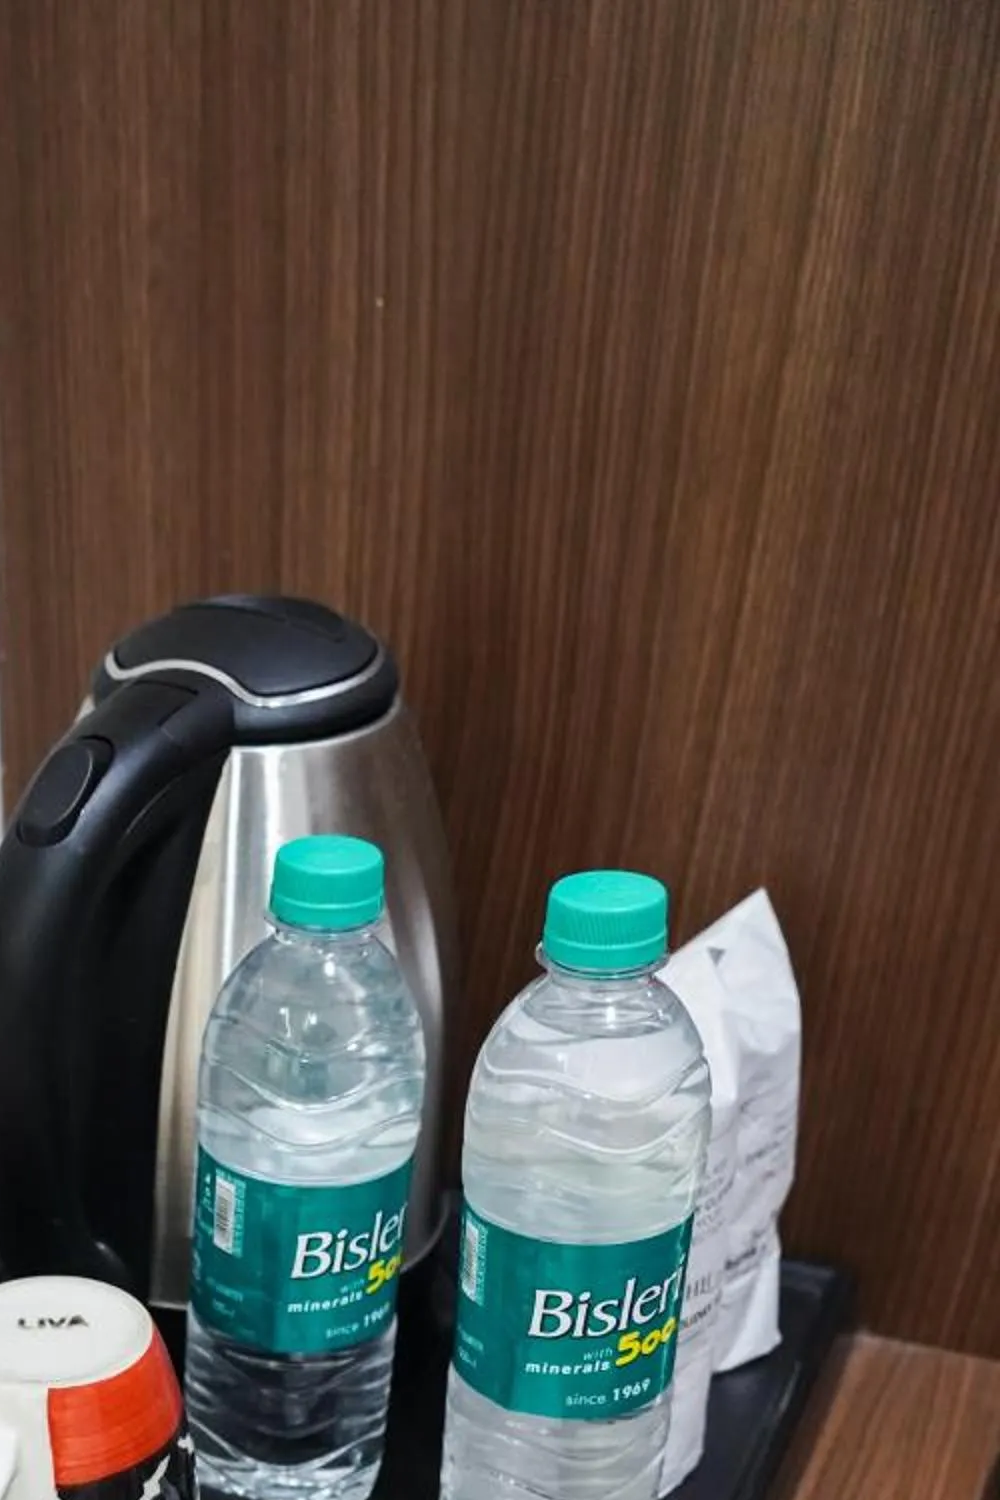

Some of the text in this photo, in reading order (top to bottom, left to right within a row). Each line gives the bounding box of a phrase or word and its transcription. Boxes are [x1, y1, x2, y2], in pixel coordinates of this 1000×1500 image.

[290, 1202, 407, 1279] Bisler
[288, 1291, 362, 1313] minerals
[527, 1253, 686, 1338] Bisleri
[17, 1314, 89, 1329] LIVA
[615, 1317, 676, 1367] 500
[525, 1360, 610, 1375] minerals
[583, 1348, 613, 1362] with
[566, 1378, 651, 1406] since 1969
